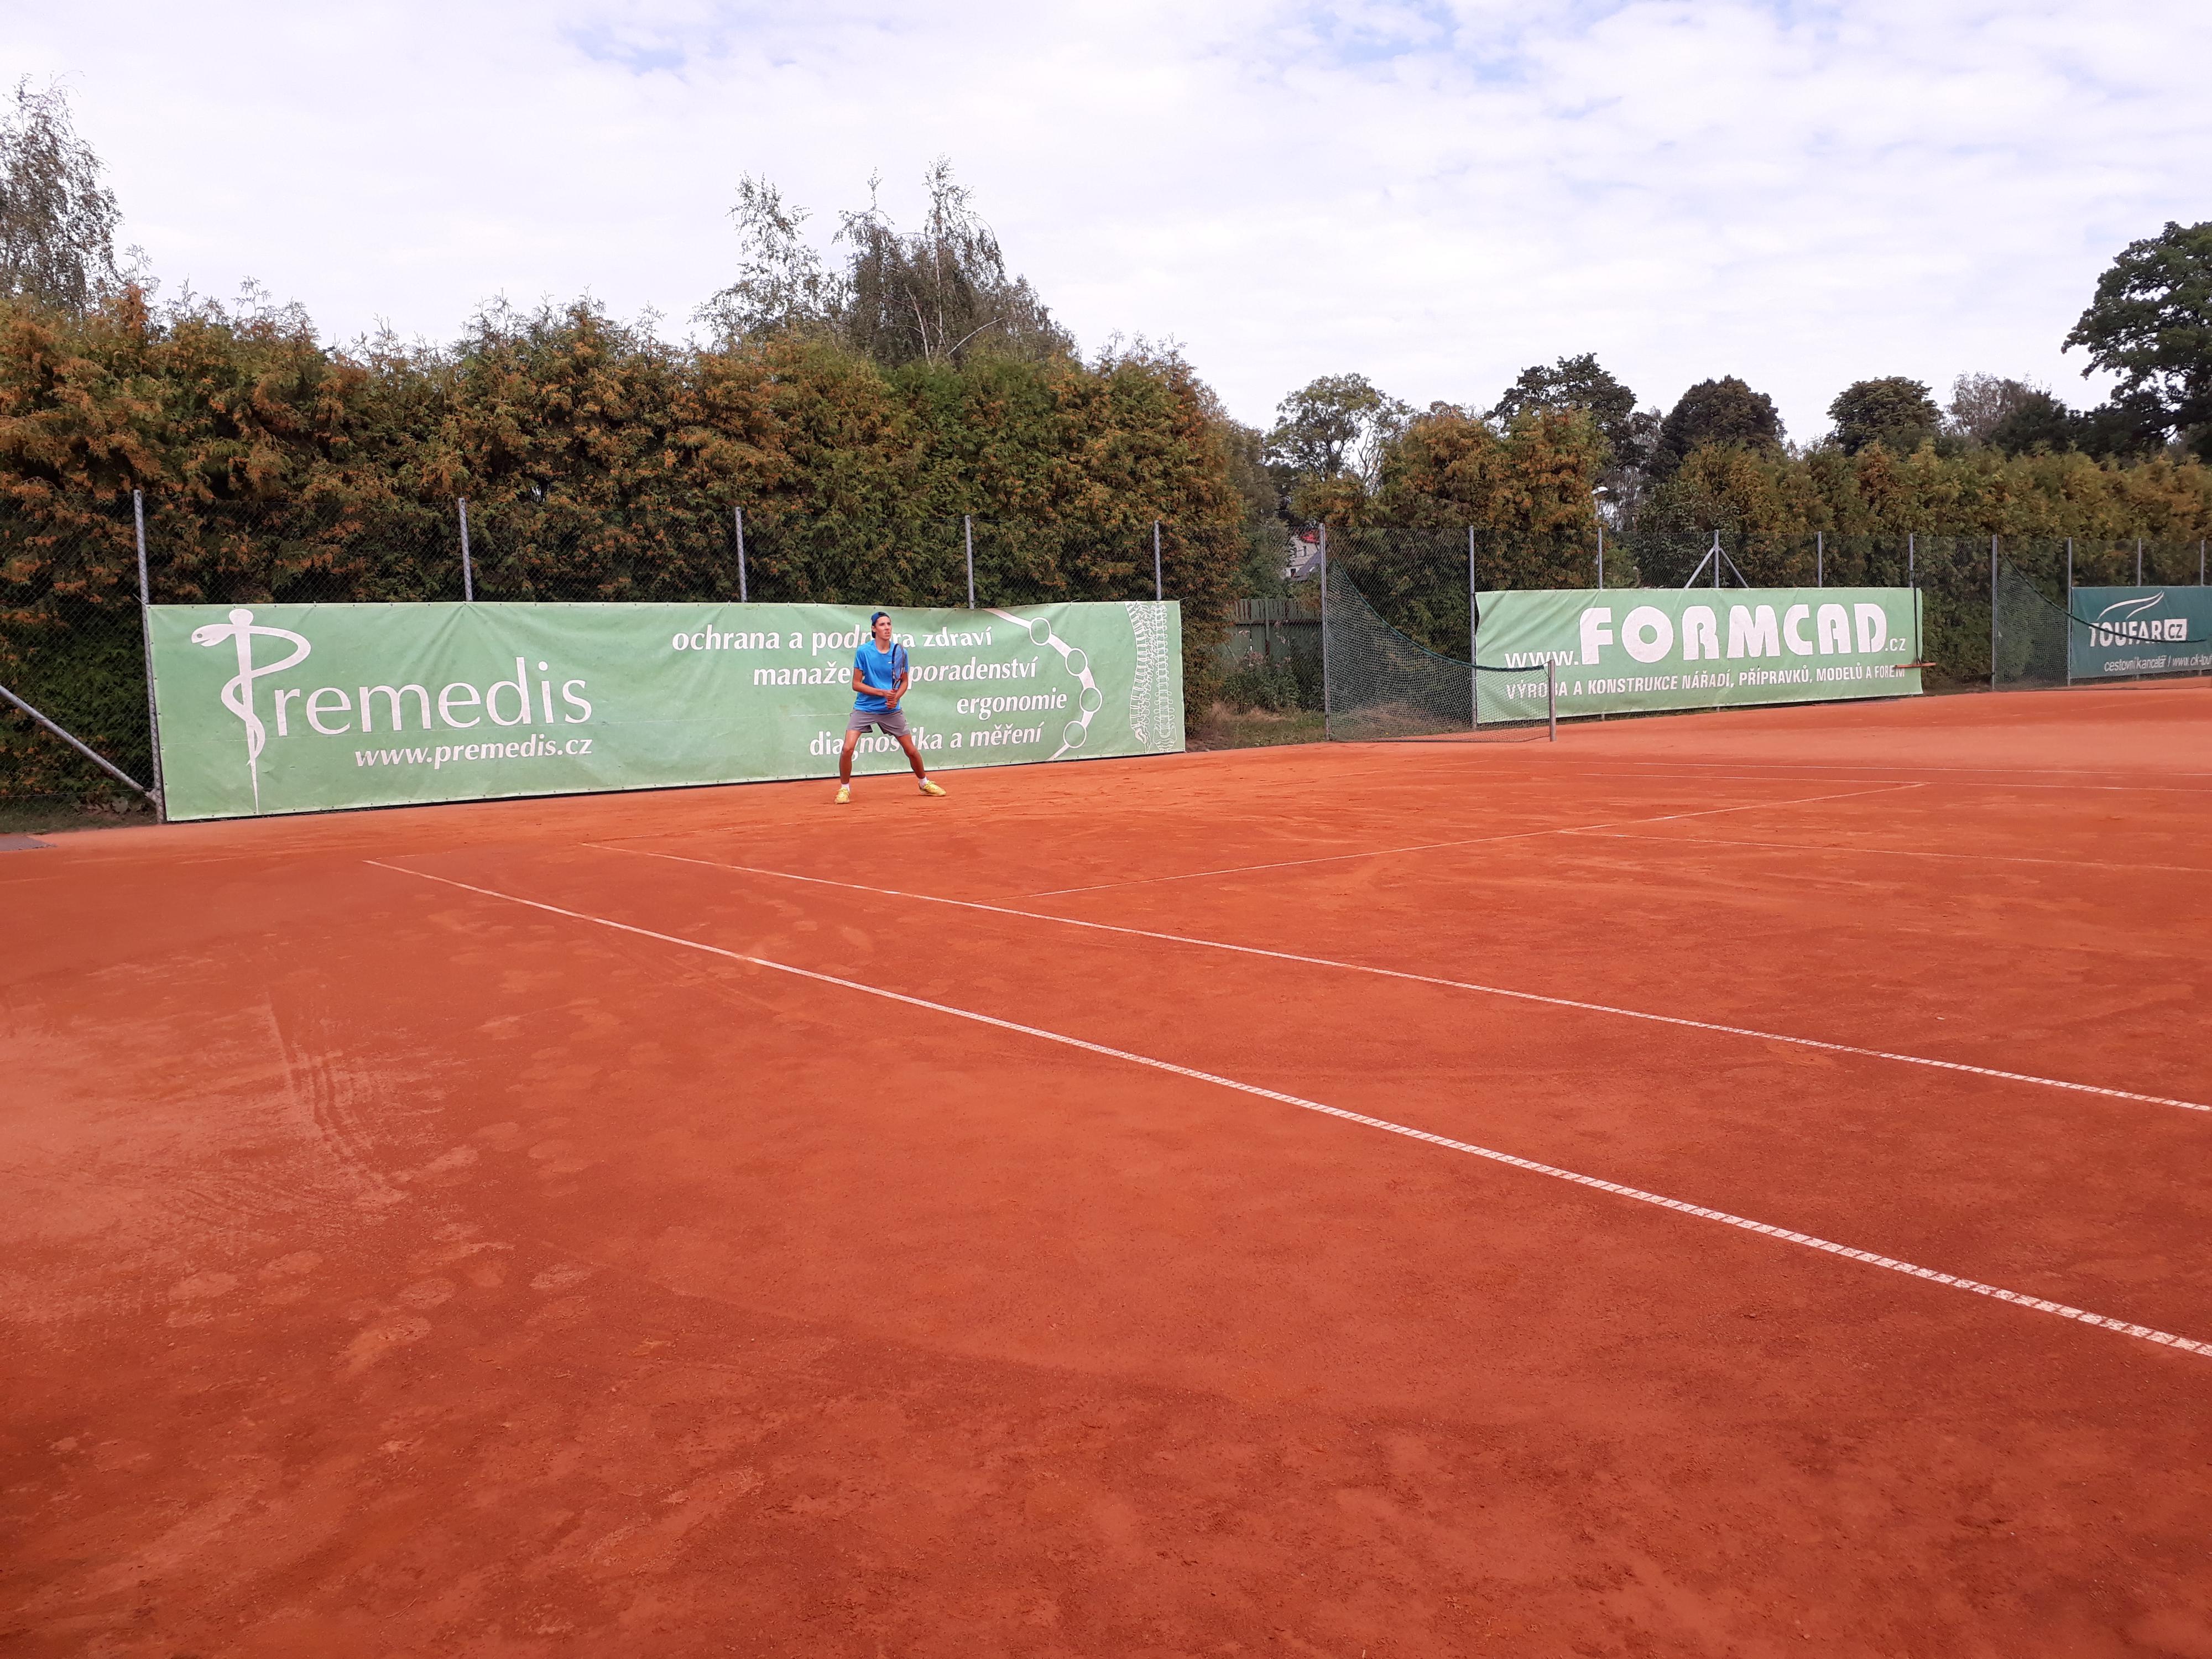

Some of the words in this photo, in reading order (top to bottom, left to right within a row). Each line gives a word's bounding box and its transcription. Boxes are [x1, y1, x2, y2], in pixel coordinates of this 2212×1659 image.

[672, 624, 780, 650] ochrana
[789, 632, 802, 649] a
[812, 624, 915, 656] podra
[922, 626, 992, 647] zdraví
[2089, 620, 2162, 647] TOUFAR
[2168, 623, 2183, 639] CZ
[907, 656, 1038, 689] poradenství
[1573, 680, 1582, 696] A
[1588, 675, 1677, 695] KONSTRUKCE
[1682, 669, 1734, 689] NÁŘADÍ,
[1739, 665, 1814, 686] PŘÍPRAVKŮ,
[1817, 662, 1862, 681] MODELŮ
[1866, 666, 1872, 679] A
[1875, 665, 1906, 678] FOREM
[191, 609, 593, 815] Premedis
[957, 687, 1067, 720] ergonomie
[354, 733, 593, 770] www.premedis.cz
[810, 727, 942, 761] dianosika
[950, 732, 962, 748] a
[970, 721, 1045, 747] měření
